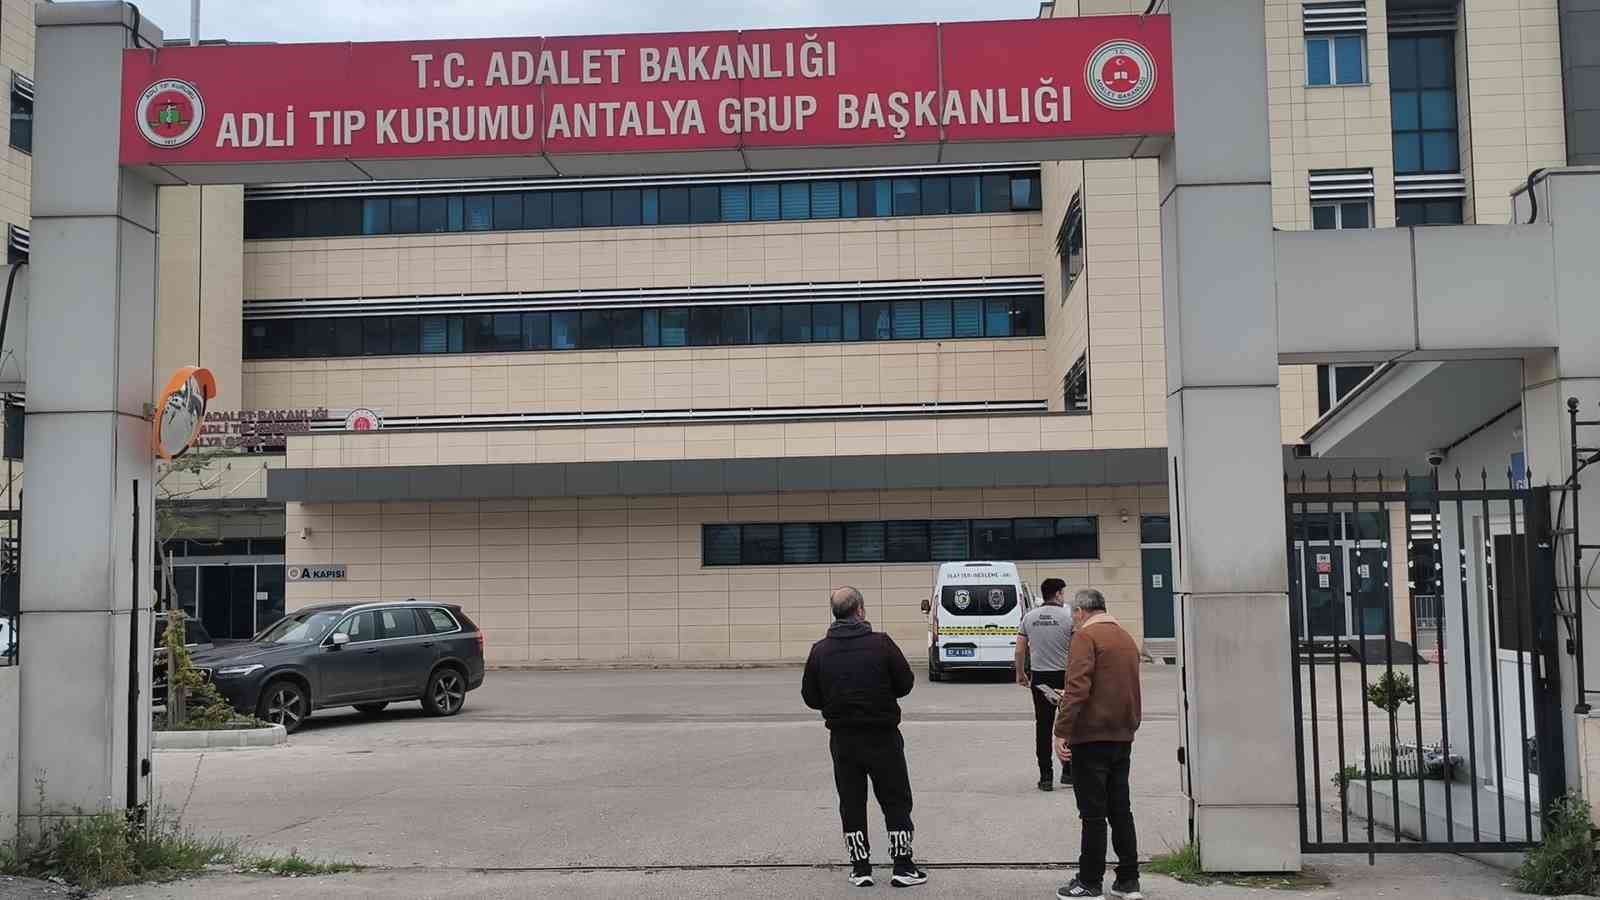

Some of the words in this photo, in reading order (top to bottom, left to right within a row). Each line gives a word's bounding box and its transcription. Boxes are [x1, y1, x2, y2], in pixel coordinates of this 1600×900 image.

[411, 53, 474, 89] T.C.
[486, 48, 625, 86] ADALET
[639, 33, 837, 83] BAKANLIĞI
[215, 105, 294, 148] ADLİ
[309, 110, 366, 146] TIP
[376, 104, 534, 145] KURUMU
[547, 99, 706, 140] ANTALYA
[718, 95, 817, 135] GRUP
[838, 77, 1072, 138] BAŞKANLIĞI
[204, 411, 256, 422] ADALET
[258, 406, 328, 421] BAKANLIĞI
[302, 568, 310, 578] A
[313, 570, 345, 578] KAPISI
